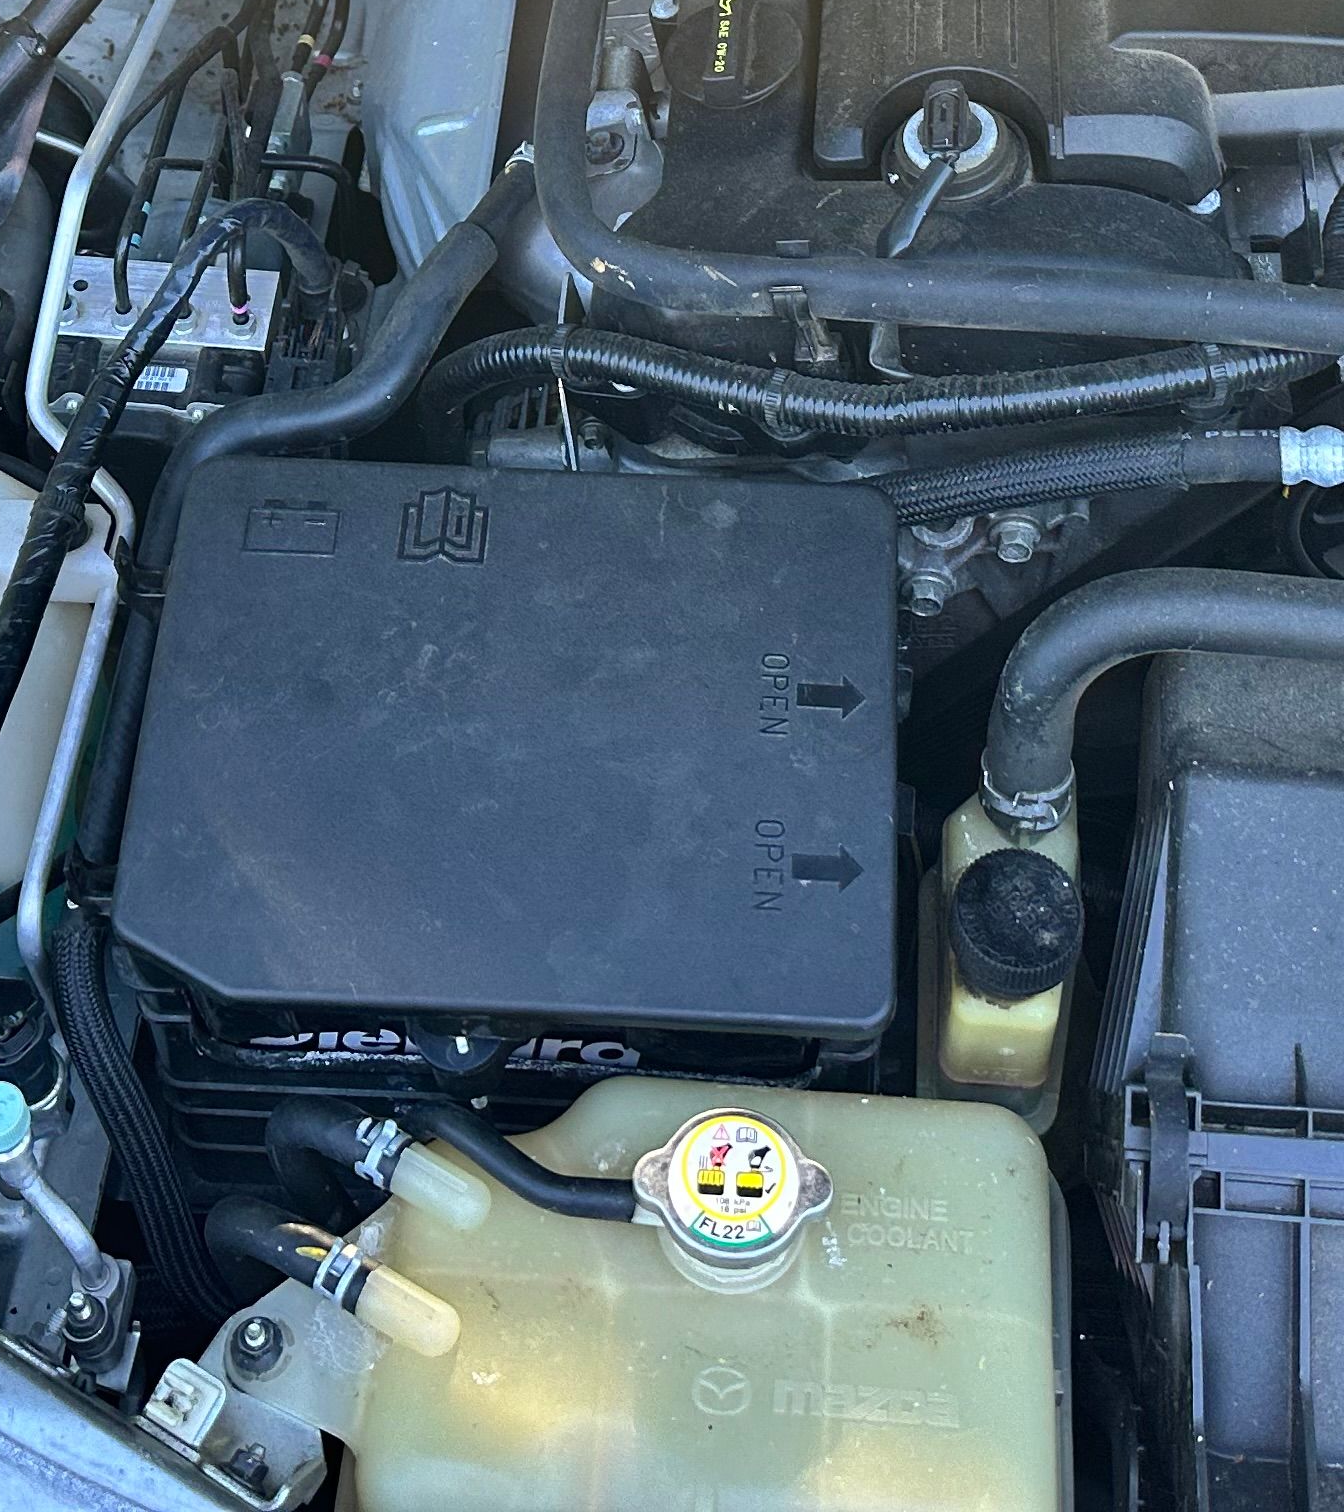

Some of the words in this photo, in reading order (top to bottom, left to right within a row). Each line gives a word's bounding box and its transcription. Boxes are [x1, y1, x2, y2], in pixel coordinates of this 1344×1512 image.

[718, 20, 731, 38] SAE
[759, 653, 790, 737] OPEN
[753, 819, 786, 912] OPEN
[840, 1193, 949, 1222] ENGINE
[698, 1216, 746, 1239] FL22
[847, 1223, 975, 1255] COOLANT
